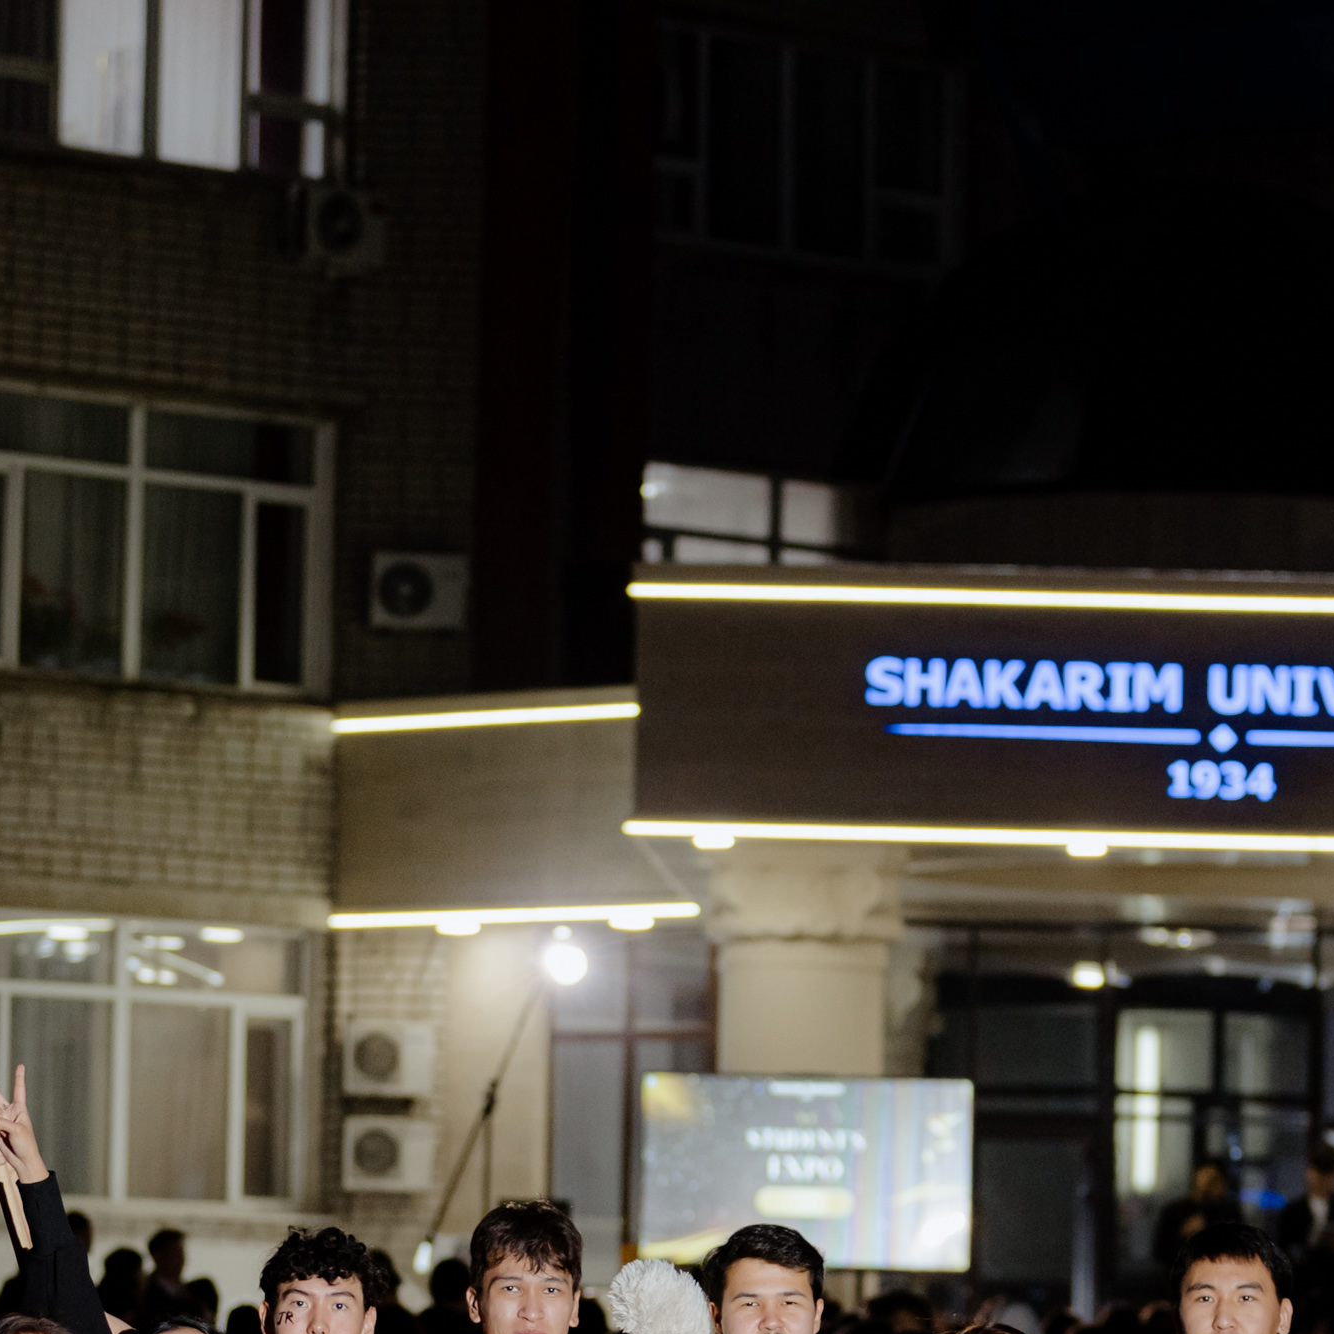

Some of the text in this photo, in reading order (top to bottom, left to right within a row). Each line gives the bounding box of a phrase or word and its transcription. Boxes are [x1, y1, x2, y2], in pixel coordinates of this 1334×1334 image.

[865, 656, 1184, 714] SHAKARIM
[1167, 759, 1277, 801] 1934
[276, 1311, 294, 1325] JR
